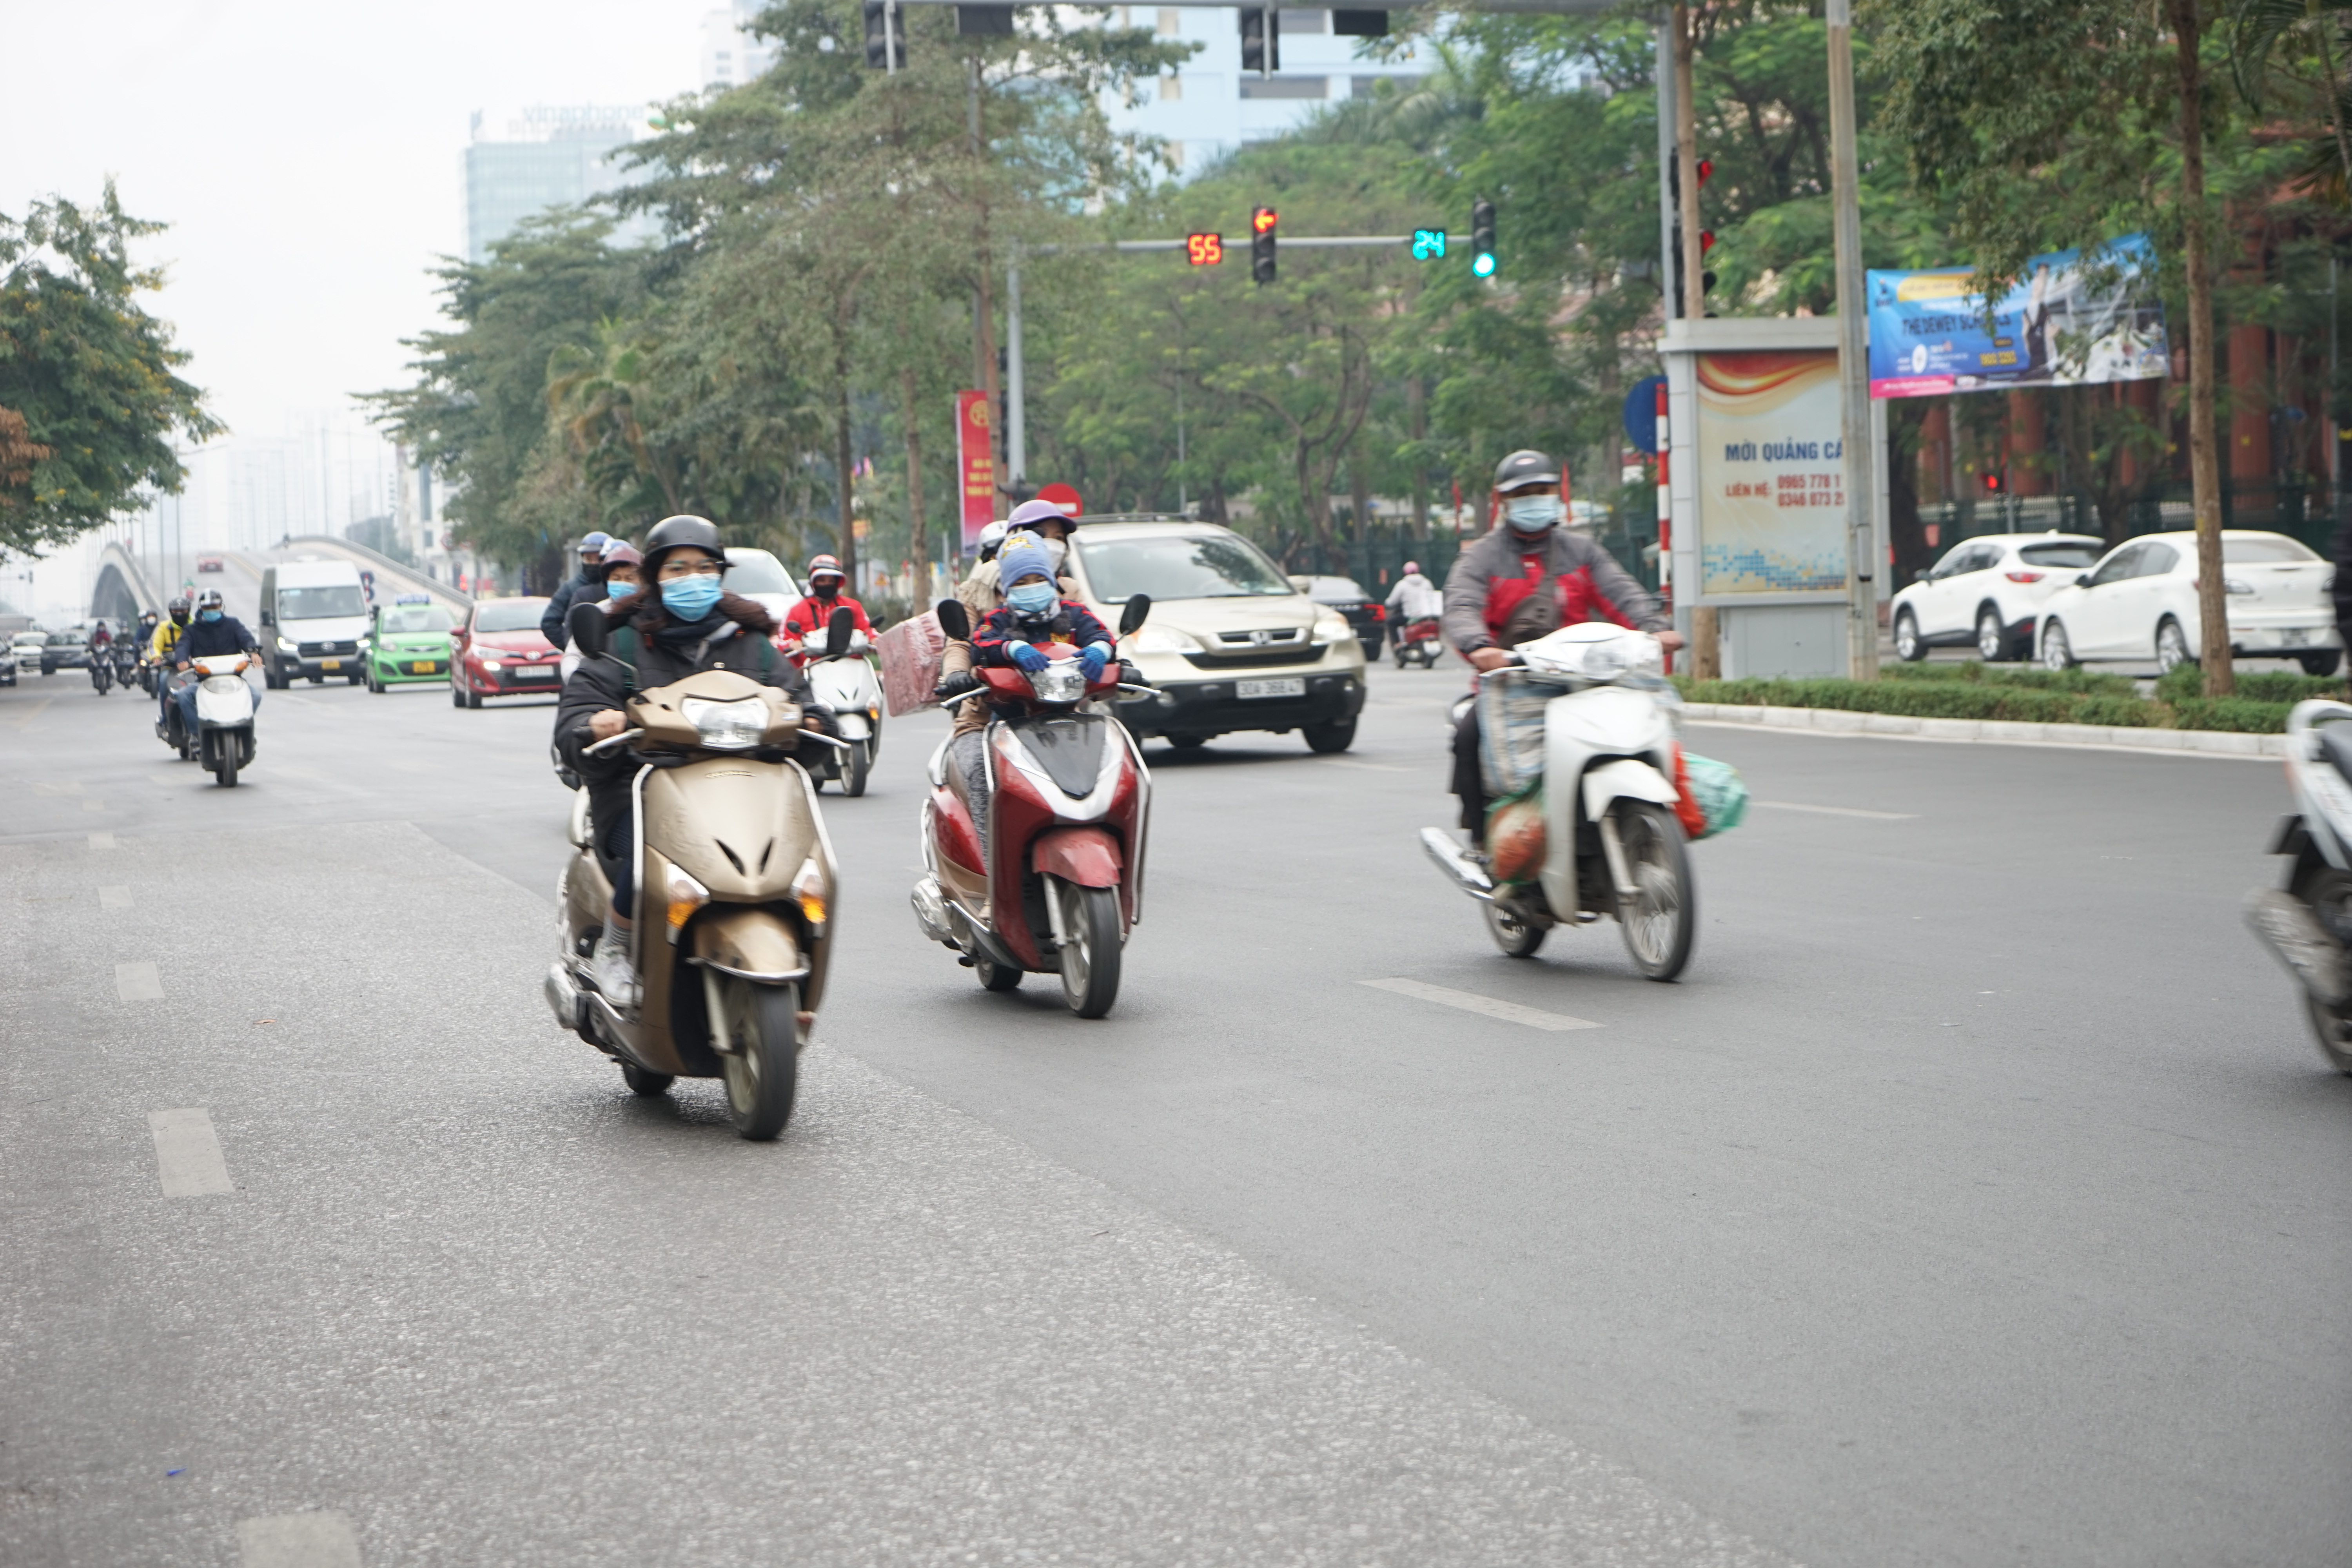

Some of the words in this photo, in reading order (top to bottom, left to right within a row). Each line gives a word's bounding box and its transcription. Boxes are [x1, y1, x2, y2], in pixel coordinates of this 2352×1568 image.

[522, 101, 643, 121] vinaphone
[1188, 234, 1221, 264] 55
[1413, 230, 1445, 260] 24
[1726, 438, 1756, 460] MỜI
[1763, 436, 1818, 461] QUẢNG
[1824, 436, 1842, 458] CÁ
